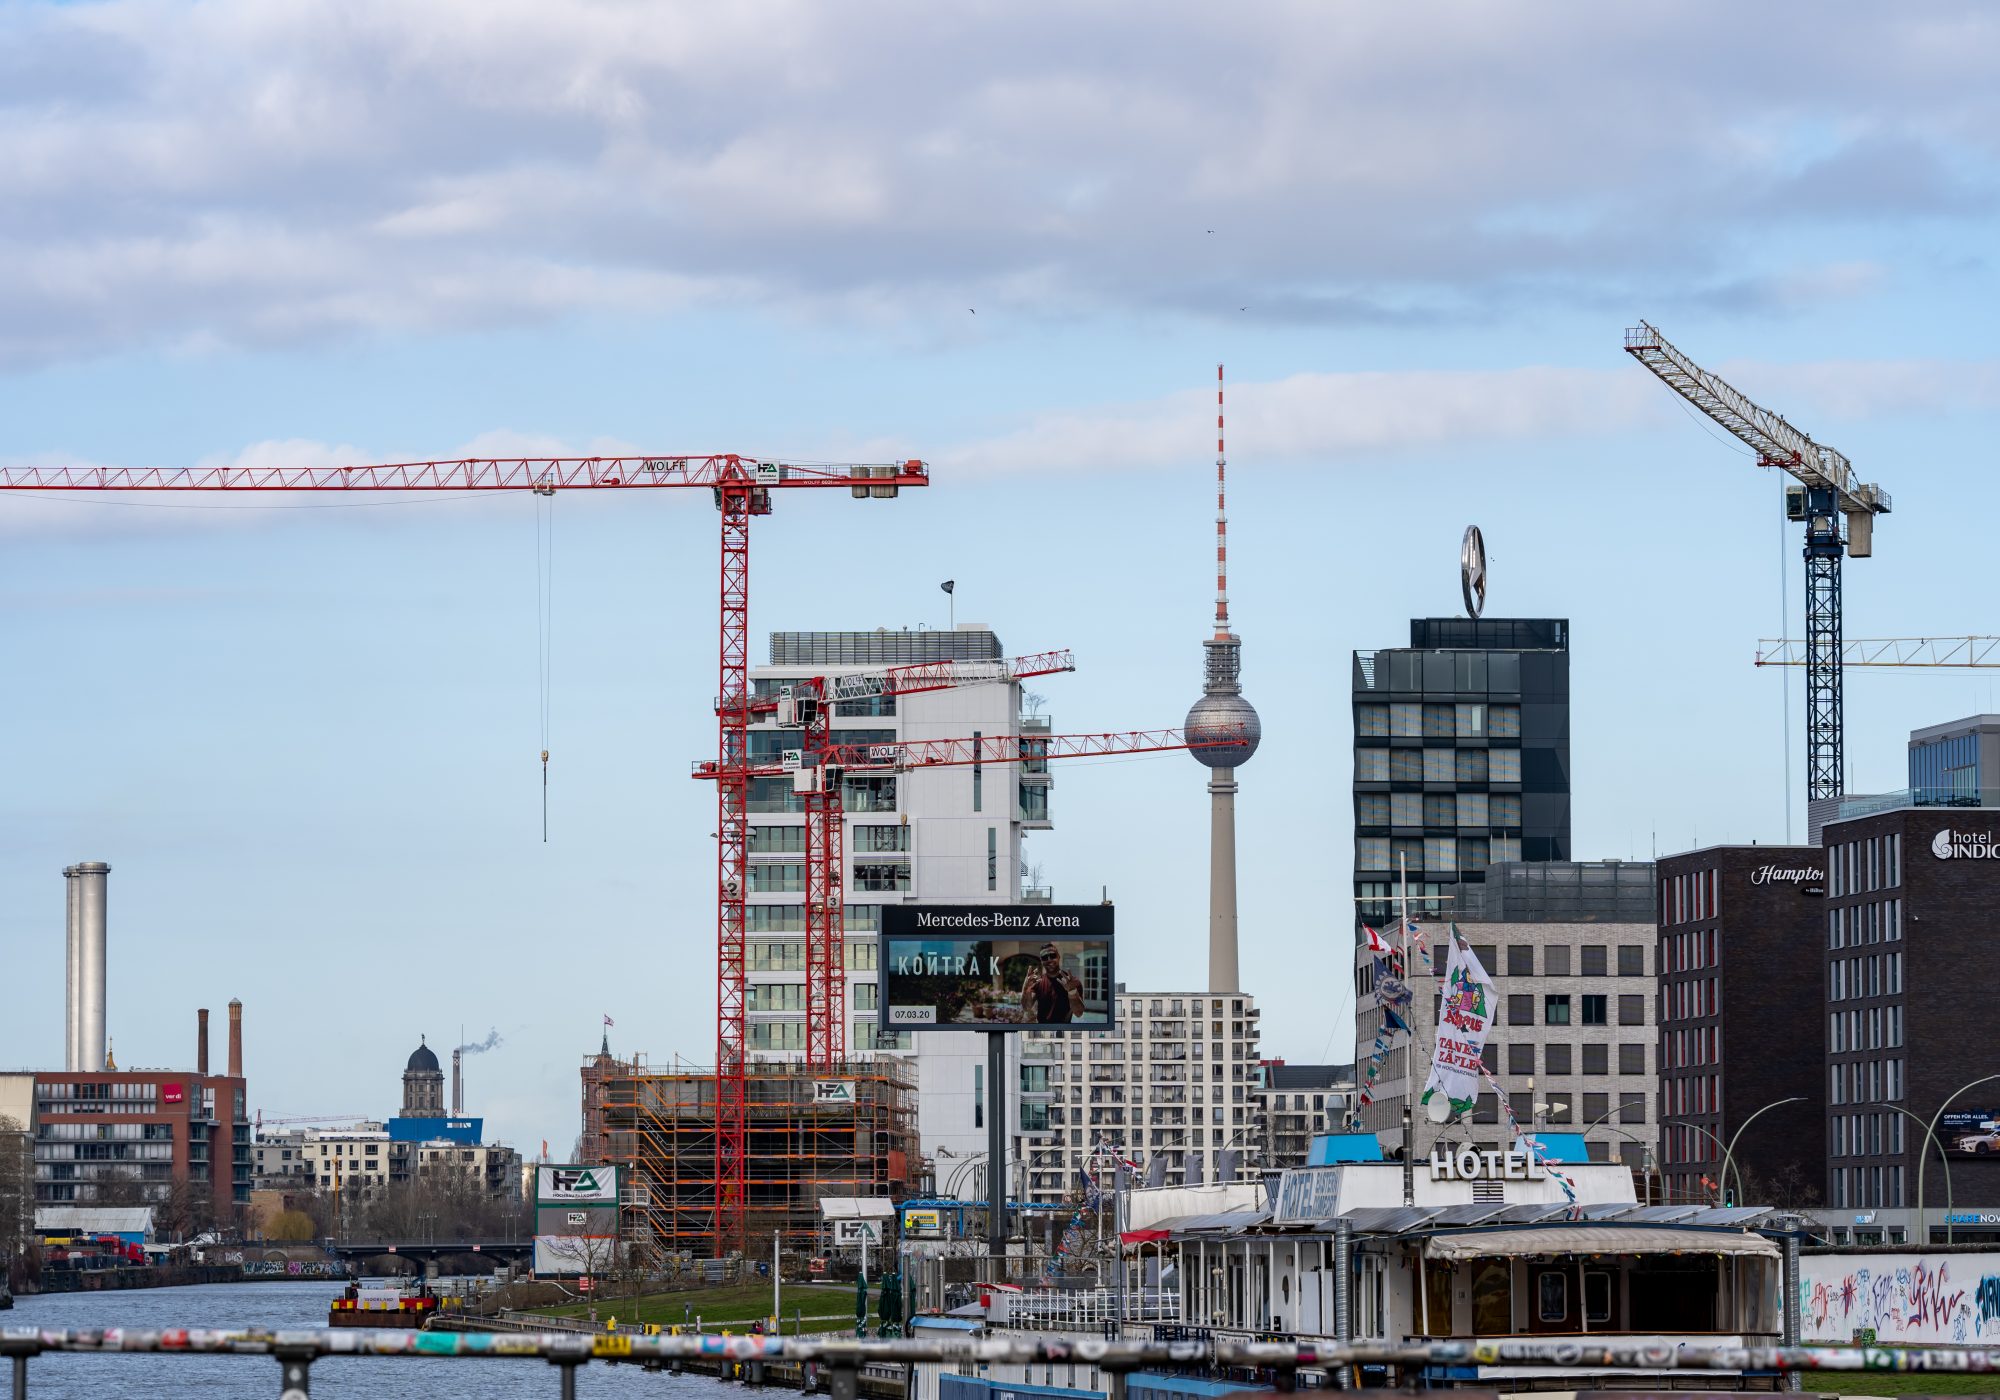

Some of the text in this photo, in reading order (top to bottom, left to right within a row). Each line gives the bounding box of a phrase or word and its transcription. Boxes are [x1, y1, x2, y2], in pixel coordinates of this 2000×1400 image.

[646, 460, 686, 472] WOLFF
[871, 746, 905, 757] WOLFF
[1953, 830, 1991, 844] hotel
[830, 897, 837, 906] 3
[917, 912, 1080, 927] Mercedes-Benz Arena
[989, 956, 1001, 976] K
[894, 1010, 930, 1019] 07.03.20
[1430, 1150, 1546, 1180] HOTEL
[1280, 1172, 1314, 1218] HOTEL
